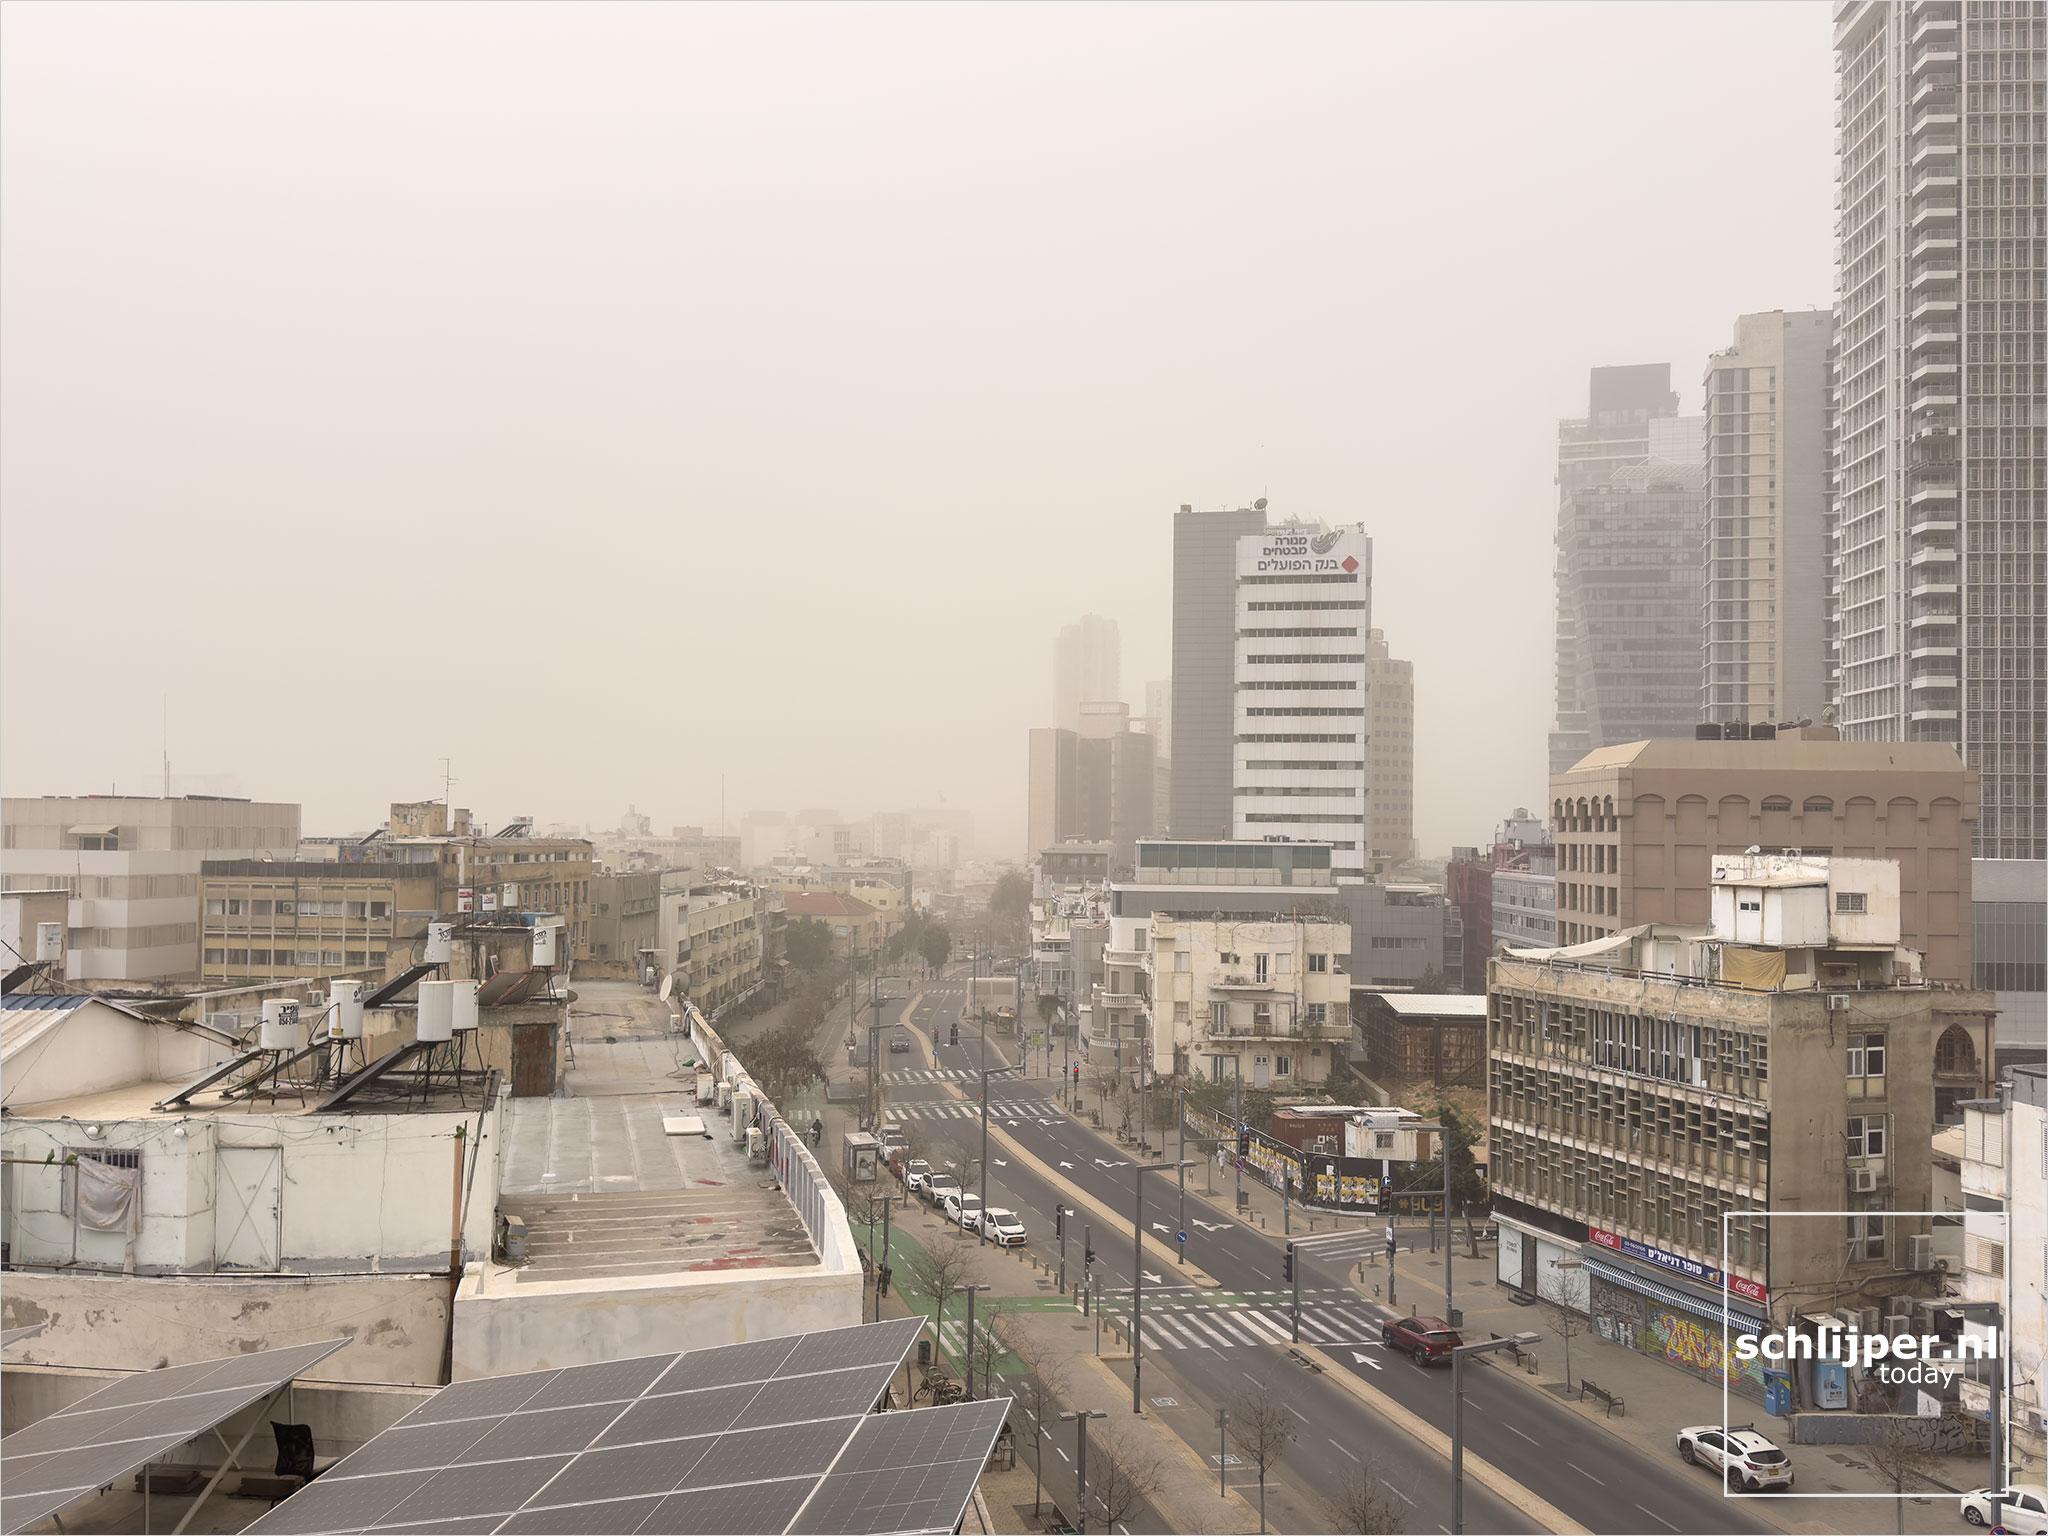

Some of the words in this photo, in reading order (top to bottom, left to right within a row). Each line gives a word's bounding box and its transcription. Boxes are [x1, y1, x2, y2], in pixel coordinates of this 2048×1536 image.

[1275, 536, 1308, 546] מנורה
[1263, 546, 1308, 556] מבטחים
[1257, 558, 1312, 571] הפועלים
[1315, 559, 1339, 572] בנק
[1682, 1258, 1703, 1275] סופר
